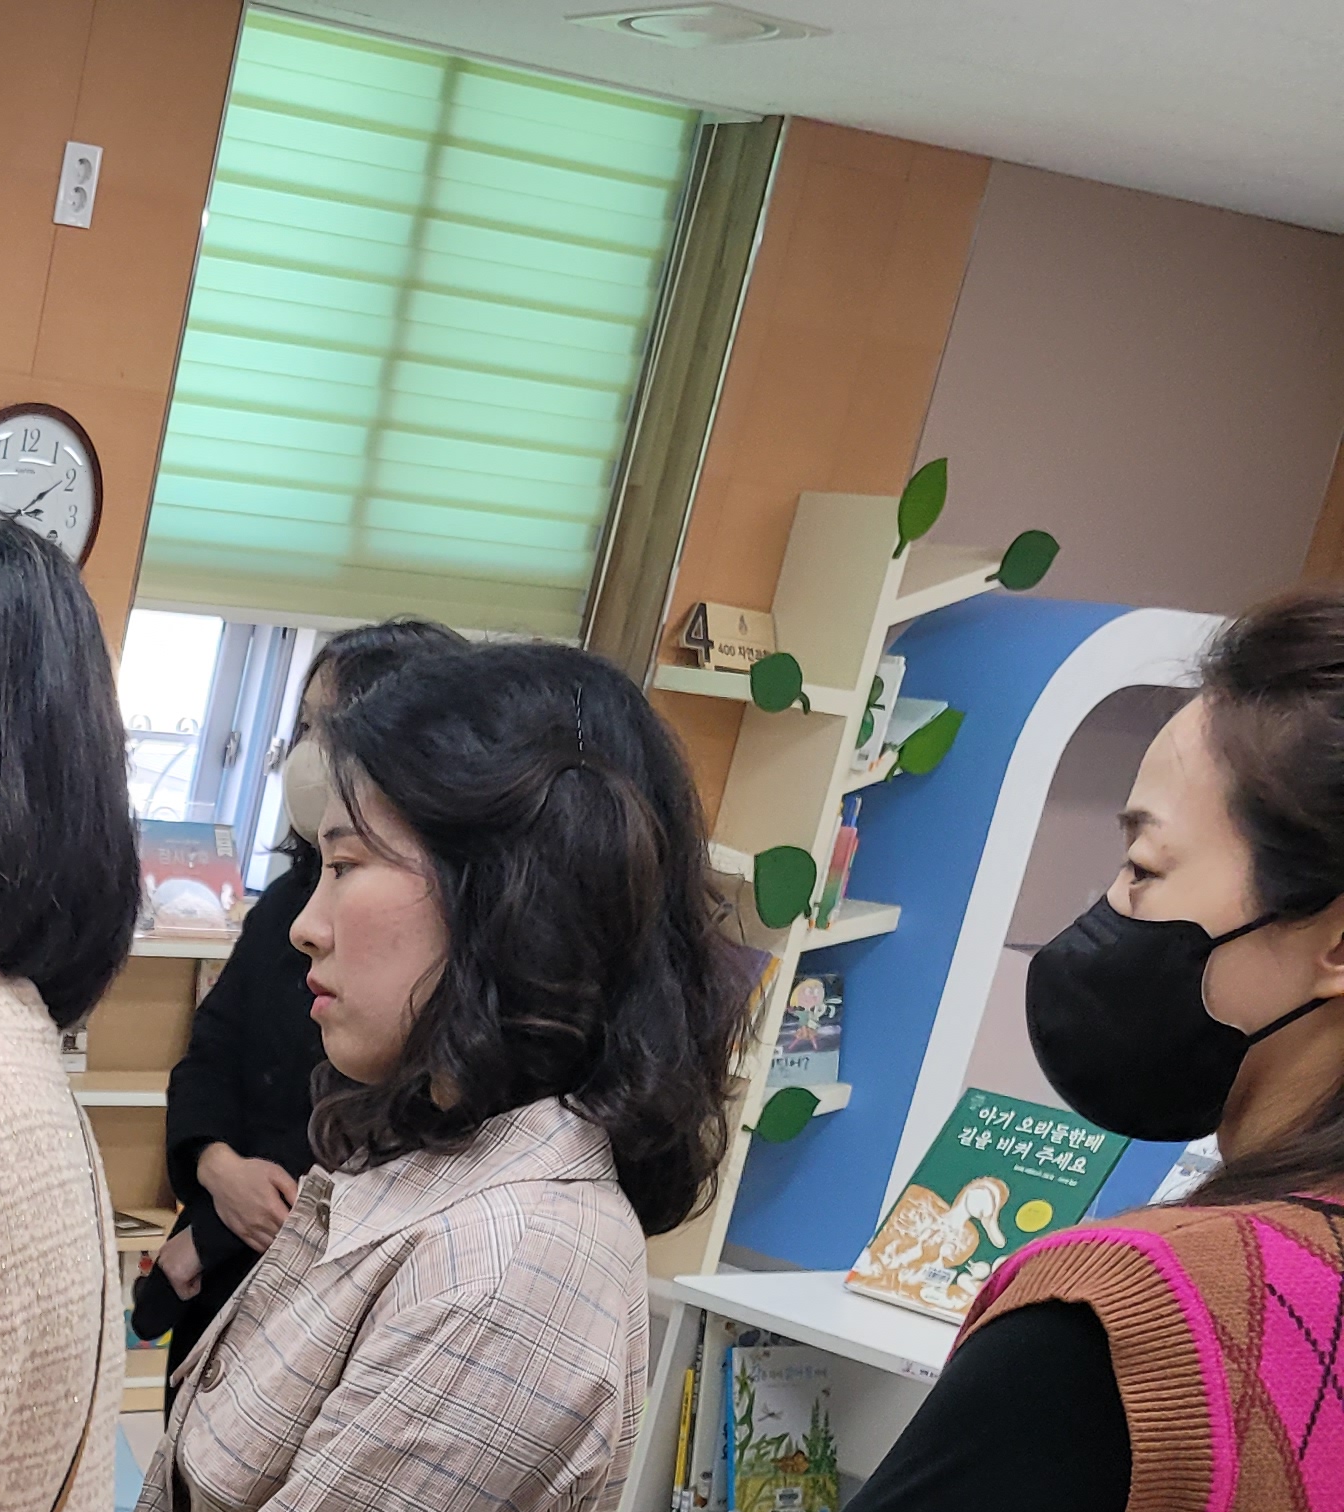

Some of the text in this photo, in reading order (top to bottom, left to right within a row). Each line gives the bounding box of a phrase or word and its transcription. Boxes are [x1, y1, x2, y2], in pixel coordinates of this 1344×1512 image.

[19, 428, 41, 452] 12
[52, 441, 60, 464] 1
[64, 468, 77, 492] 2
[65, 504, 78, 529] 3
[685, 602, 714, 663] 4
[718, 643, 736, 657] 400
[978, 1106, 1106, 1153] 아기 오리들한테
[957, 1126, 1088, 1174] 길을 비켜 주세요
